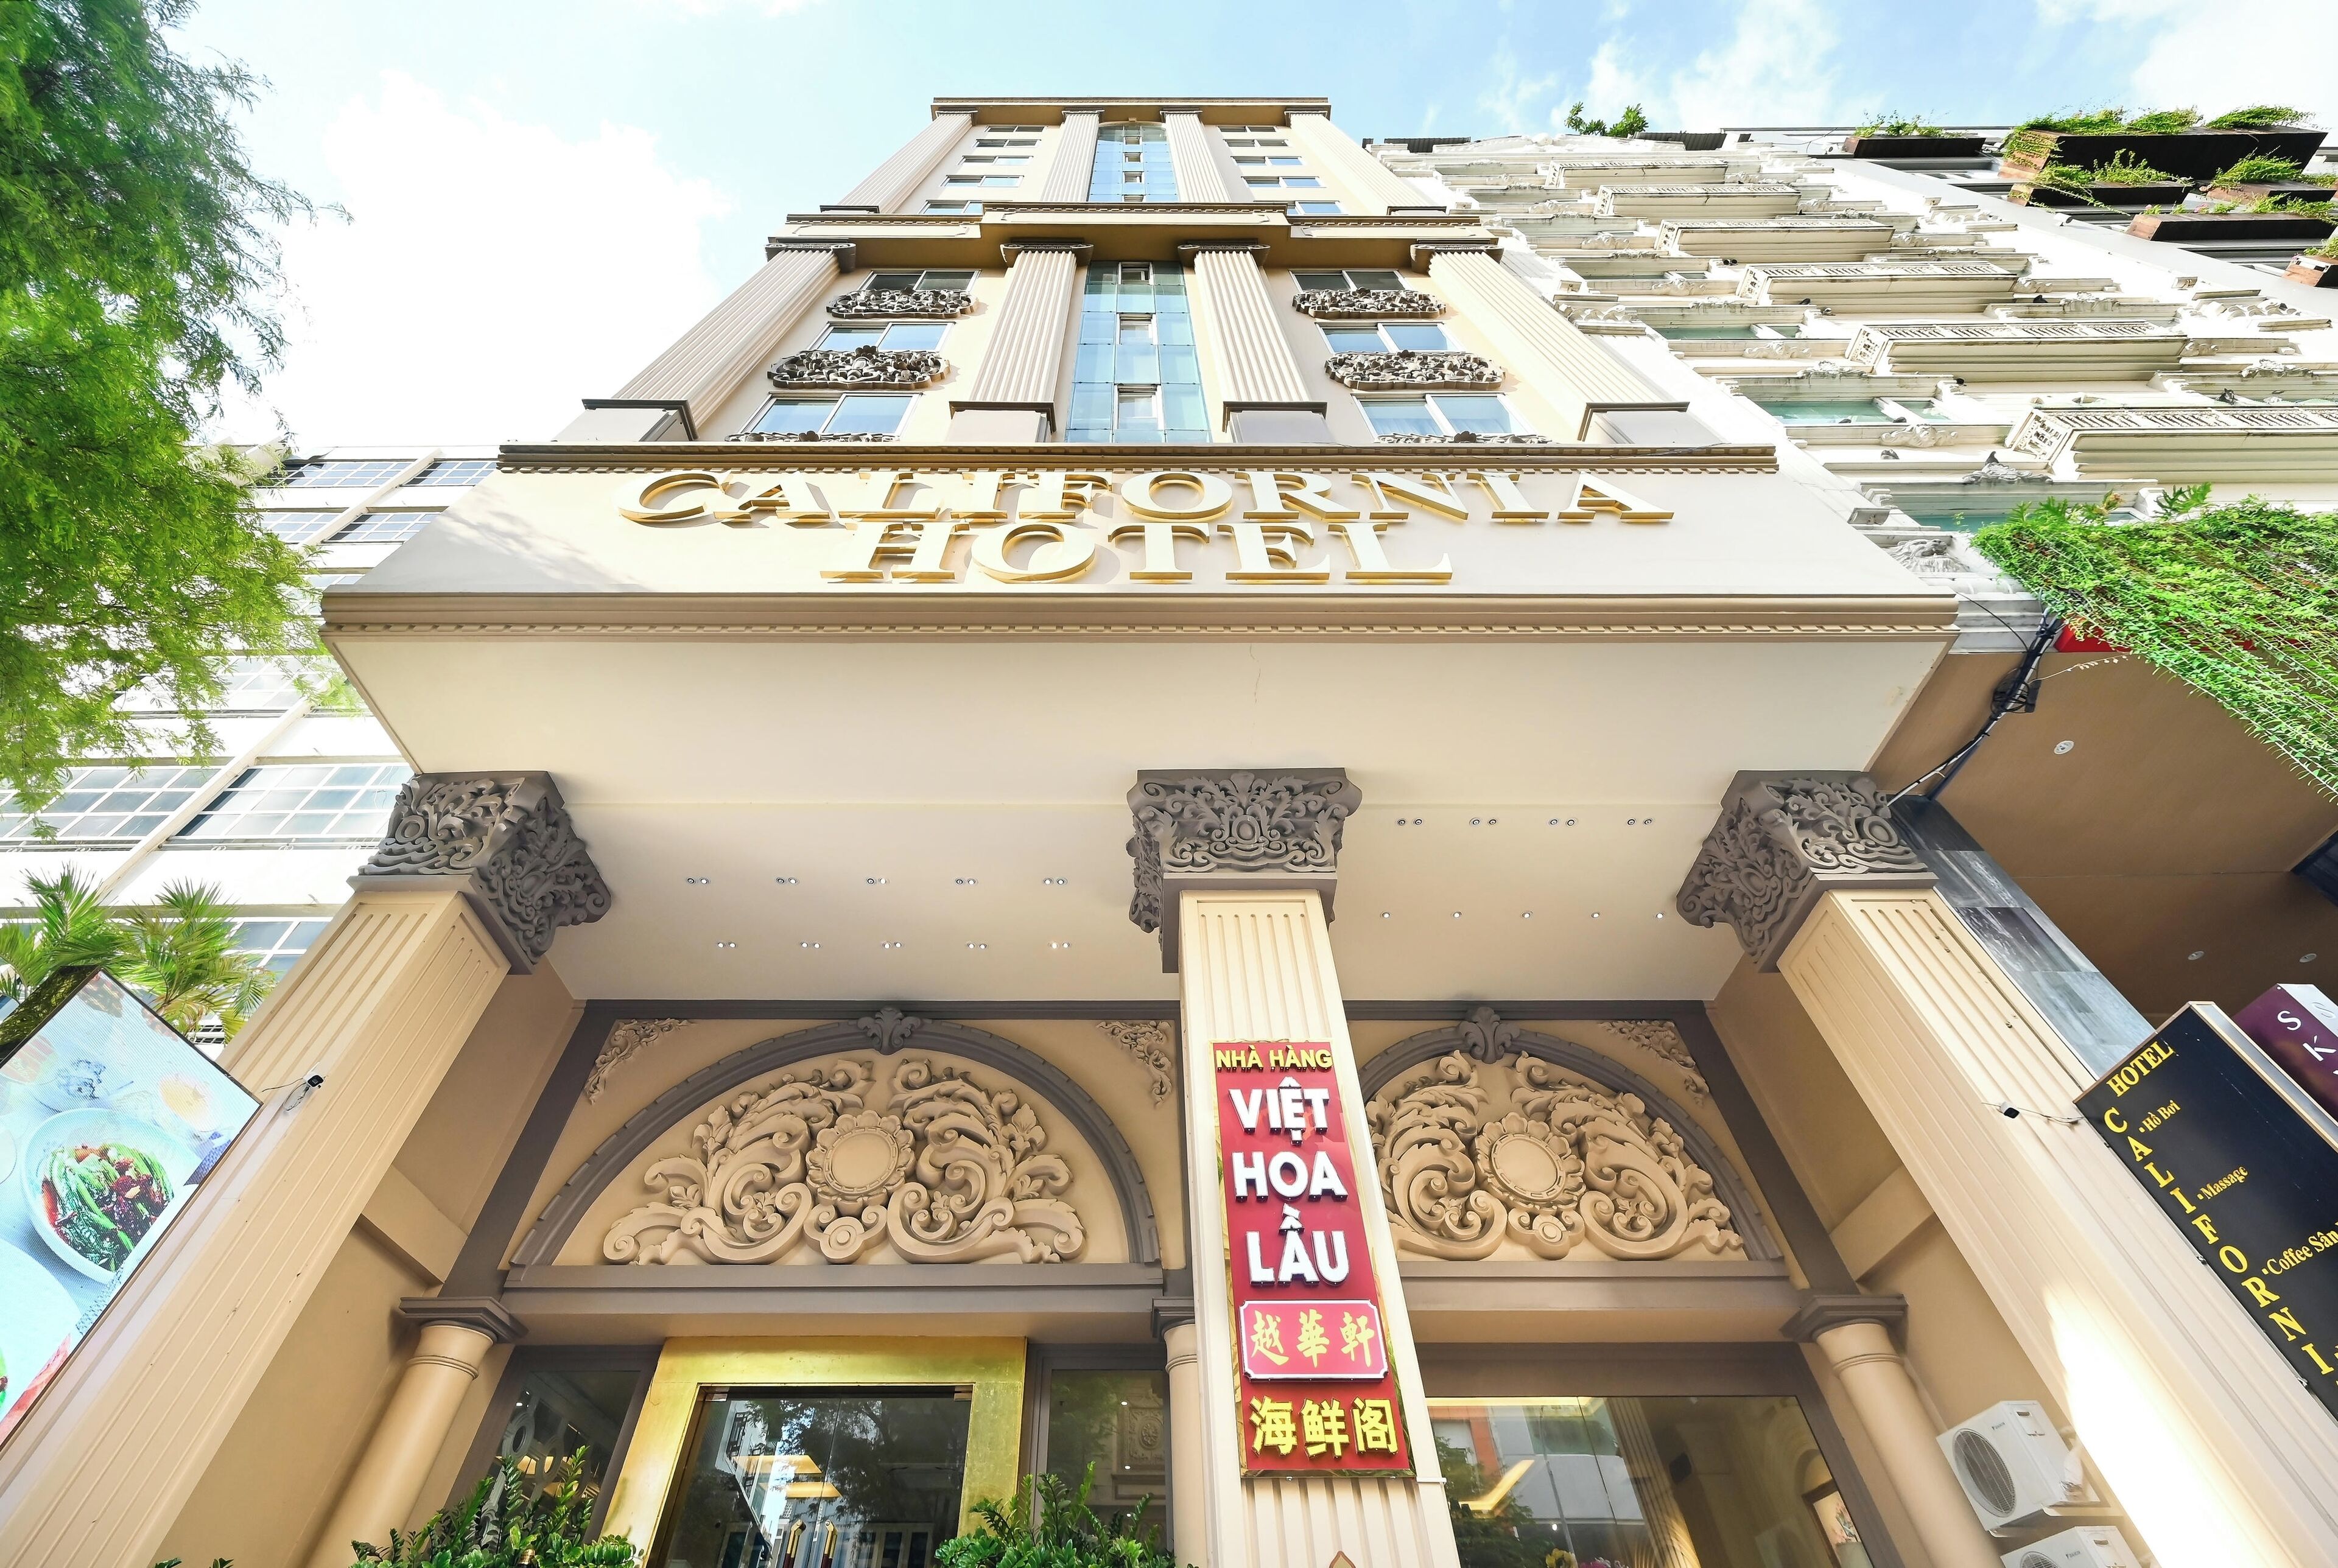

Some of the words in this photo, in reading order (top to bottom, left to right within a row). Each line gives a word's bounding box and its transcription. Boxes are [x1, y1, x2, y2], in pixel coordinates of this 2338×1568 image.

[615, 471, 1674, 523] CALIFORNIA
[820, 522, 1453, 583] HOTEL
[1216, 1045, 1263, 1071] NHÀ
[1269, 1045, 1333, 1072] HÀNG
[2106, 1041, 2174, 1097] HOTEL
[1228, 1076, 1330, 1146] VIỆT
[2142, 1111, 2161, 1131] Hồ
[1232, 1150, 1348, 1202] HOA
[2200, 1166, 2248, 1200] Massage
[1246, 1203, 1349, 1286] LẦU
[2104, 1107, 2338, 1387] CALIFORNI
[2267, 1246, 2313, 1275] Coffee
[1251, 1309, 1375, 1368] 越華軒
